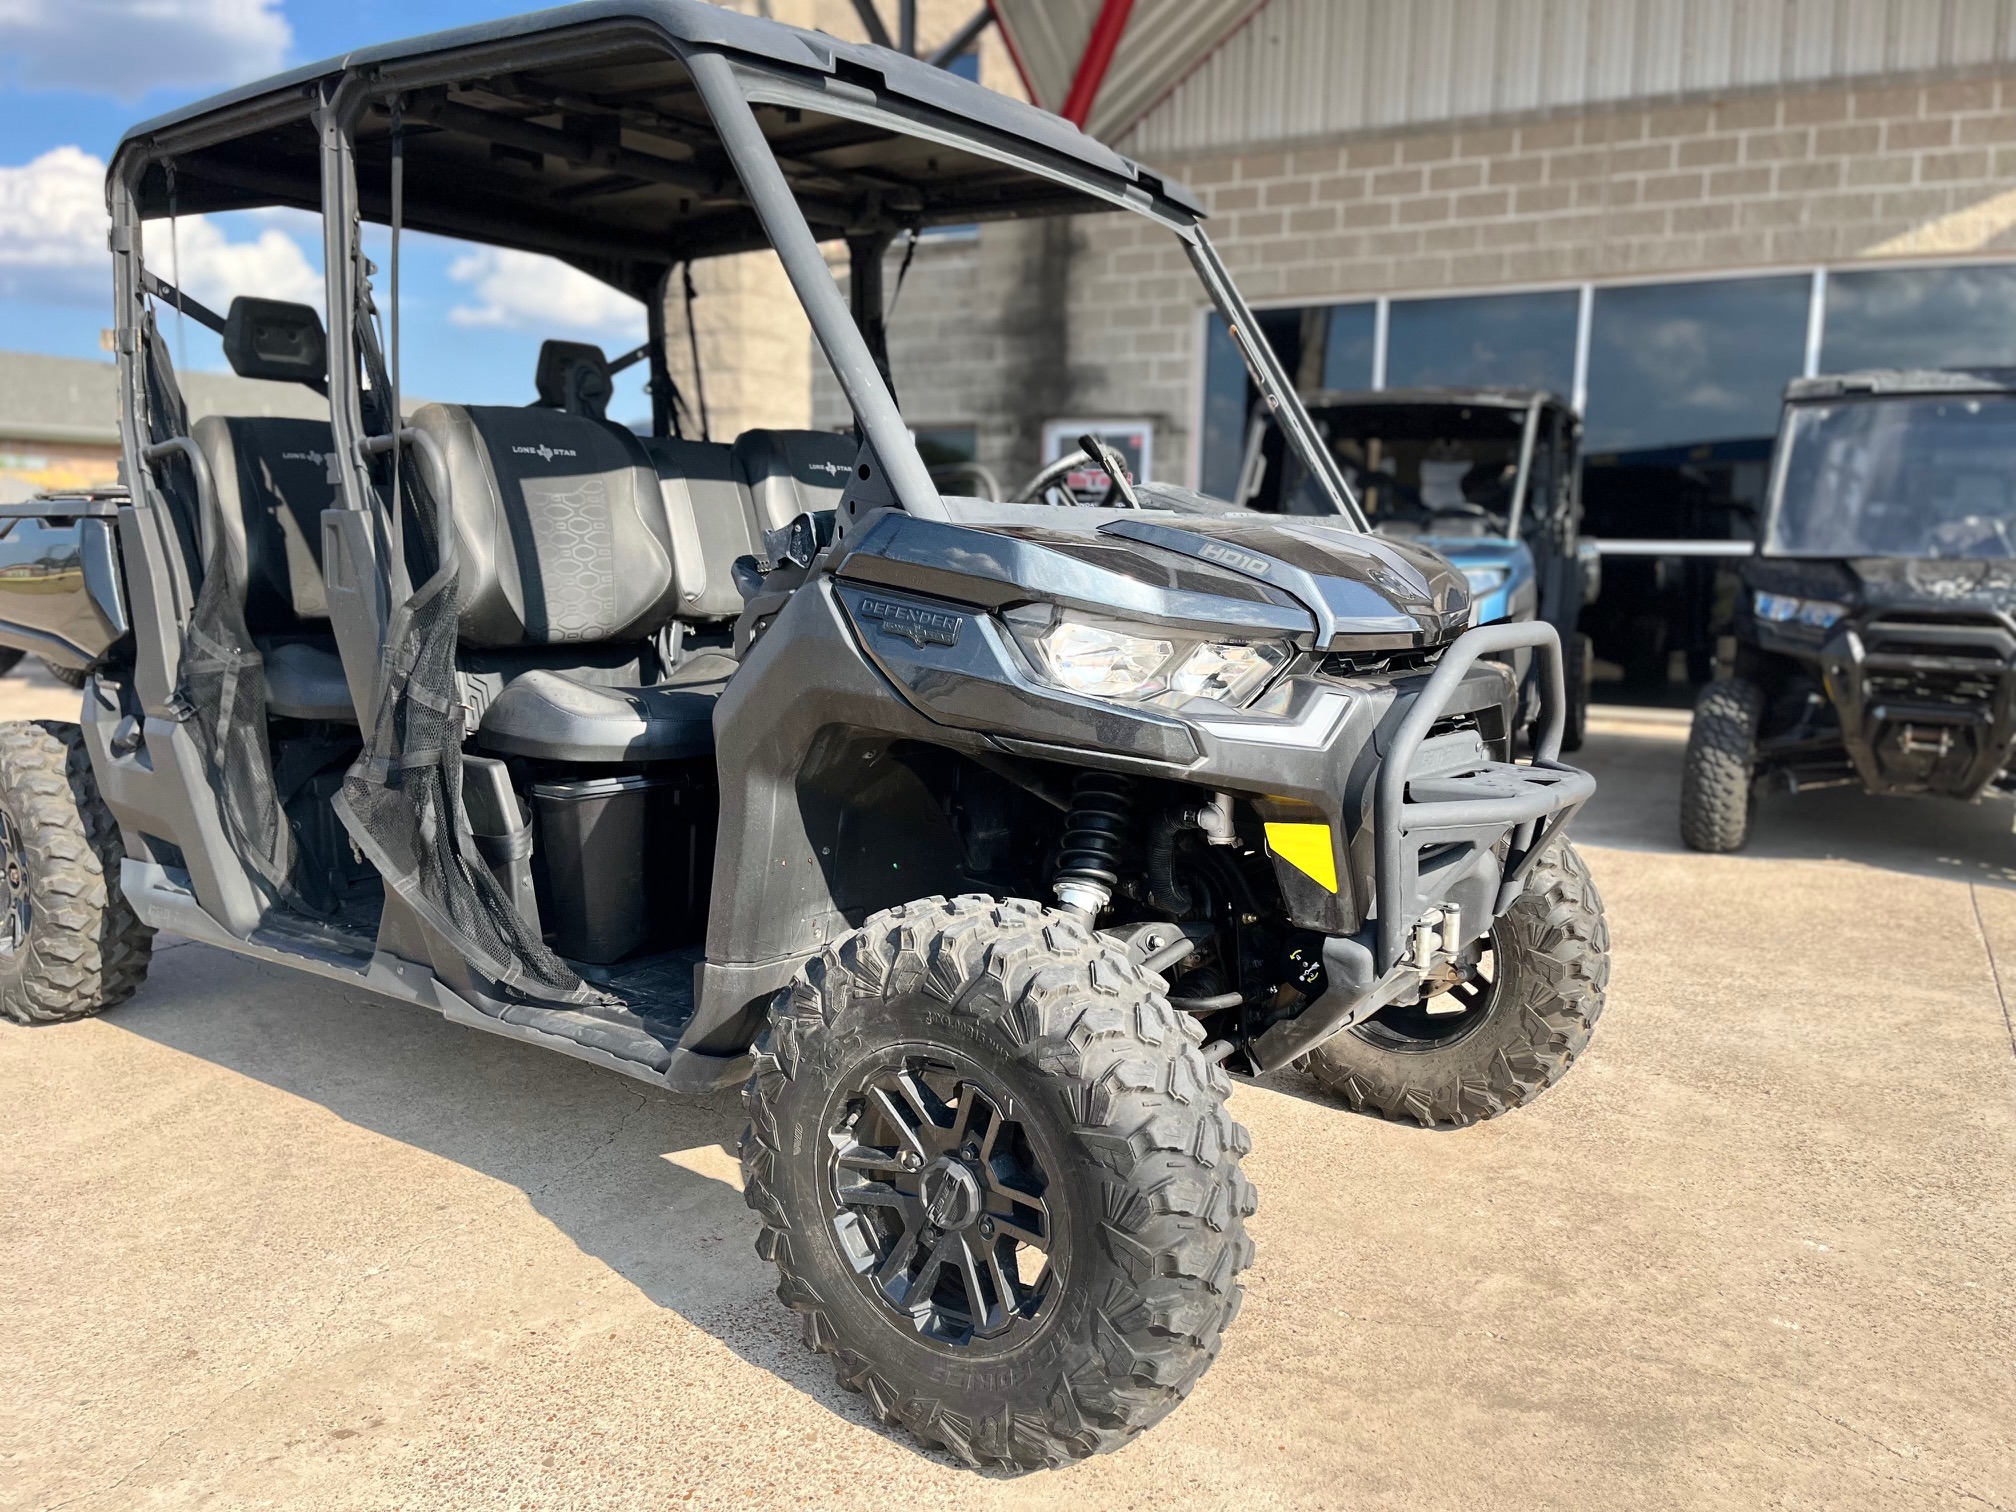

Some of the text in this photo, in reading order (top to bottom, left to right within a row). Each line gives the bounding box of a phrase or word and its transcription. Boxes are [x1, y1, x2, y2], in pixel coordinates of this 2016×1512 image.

[511, 445, 577, 457] LONE STAR
[1200, 541, 1271, 575] HD10
[861, 599, 956, 631] DEFENDER
